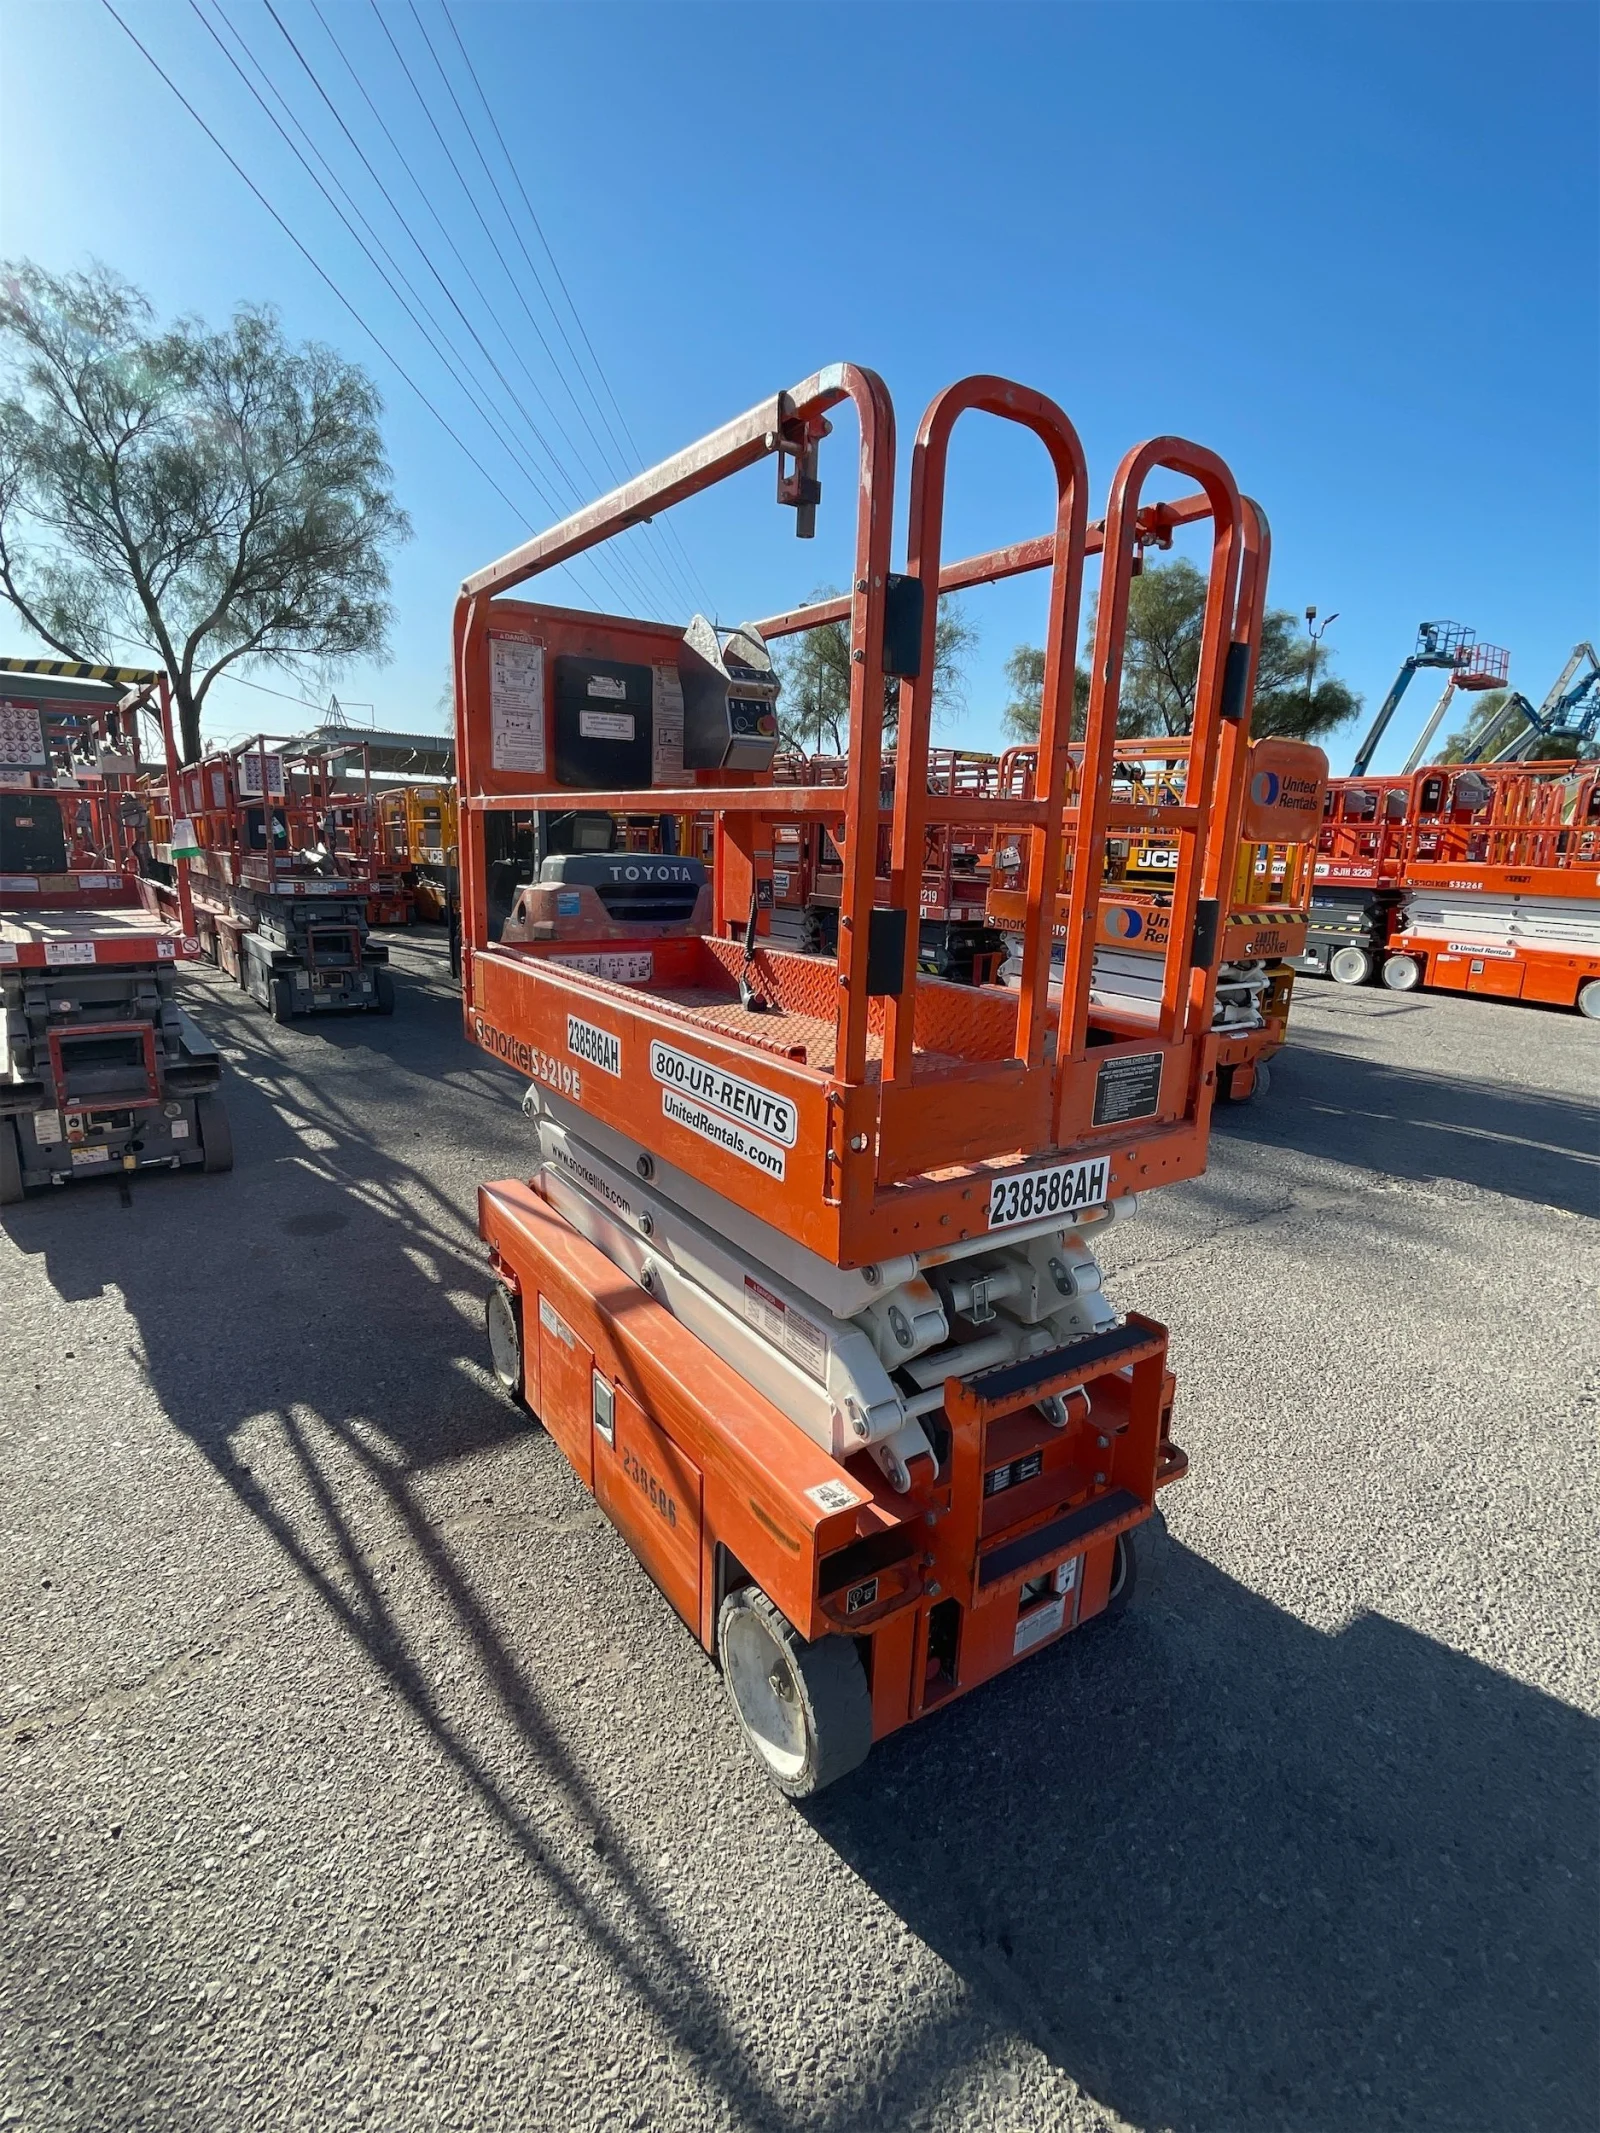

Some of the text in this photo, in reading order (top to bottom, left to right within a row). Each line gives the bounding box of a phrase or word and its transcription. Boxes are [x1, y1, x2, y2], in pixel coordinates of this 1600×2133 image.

[1279, 792, 1318, 810] Rentals
[1282, 775, 1318, 794] United
[609, 866, 692, 881] TOYOTA
[1352, 868, 1372, 877] 3226
[996, 917, 1026, 930] snork
[1253, 940, 1289, 955] snorkel
[1460, 945, 1513, 956] United Rentals
[484, 1024, 532, 1070] snorkel
[531, 1047, 581, 1101] S3219E
[568, 1018, 620, 1074] 238586AH
[656, 1052, 789, 1134] 800-UR-RENTS
[664, 1094, 784, 1175] UnitedRentals.com
[551, 1142, 631, 1216] www.snorkellifts.com
[990, 1162, 1106, 1225] 238586AH
[623, 1446, 677, 1528] 238586
